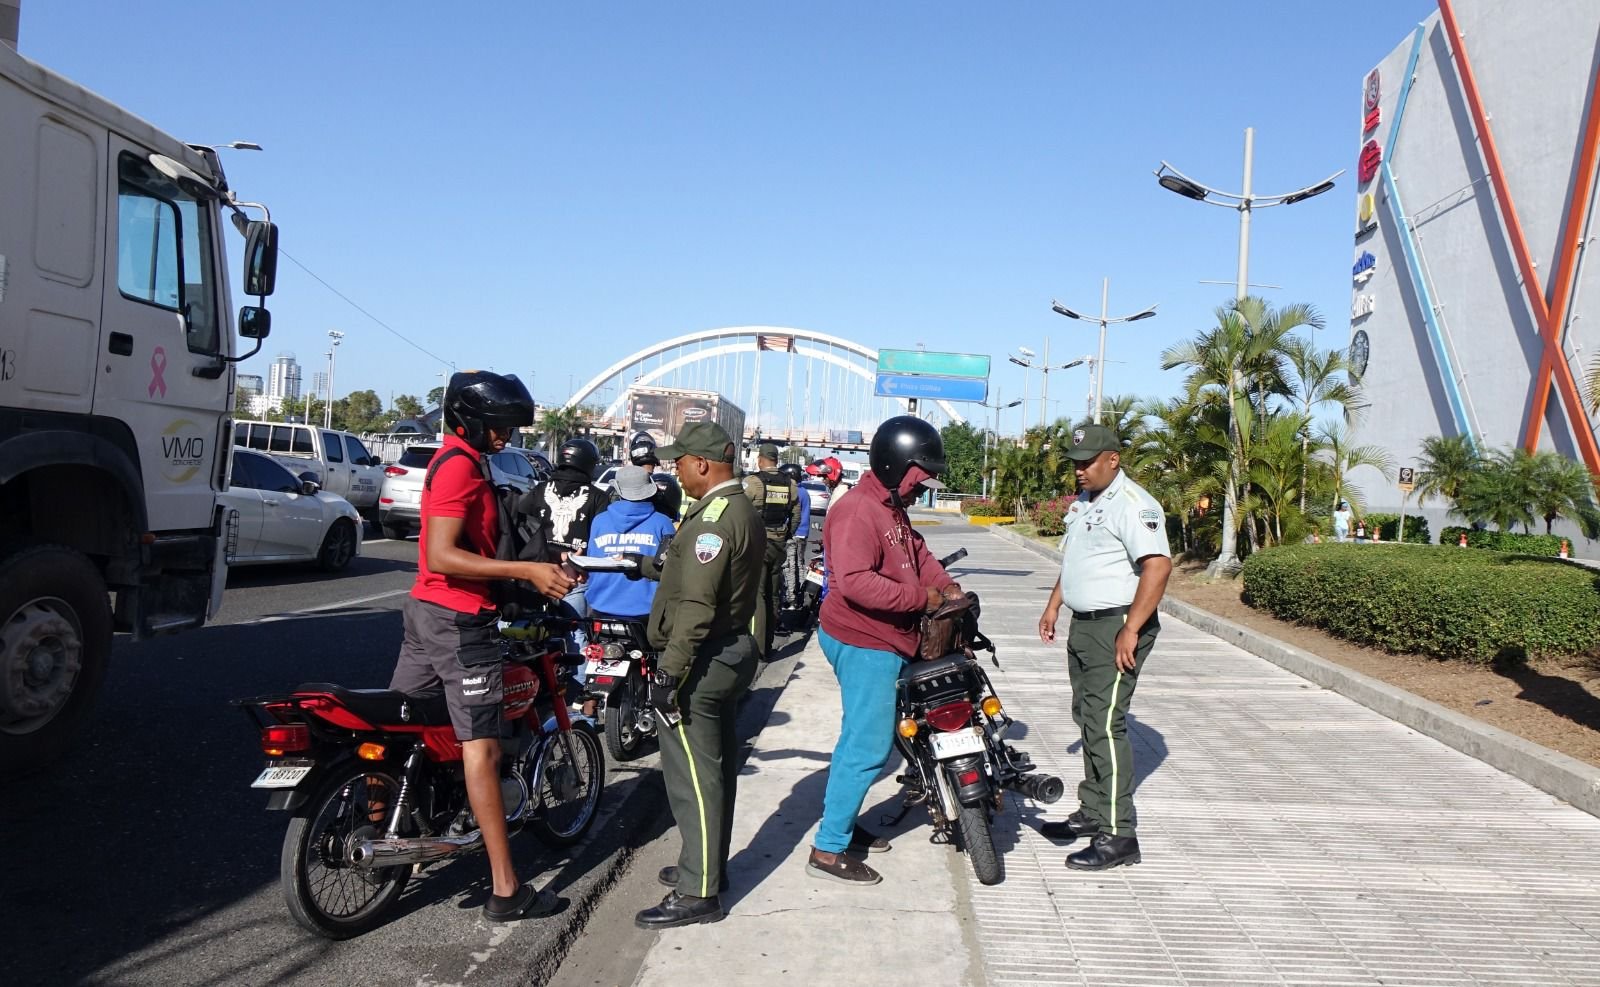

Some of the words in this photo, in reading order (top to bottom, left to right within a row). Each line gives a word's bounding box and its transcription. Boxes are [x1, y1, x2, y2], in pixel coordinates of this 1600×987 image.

[162, 437, 204, 458] VMO
[462, 676, 481, 686] Mobil
[503, 680, 535, 696] SUZUKI
